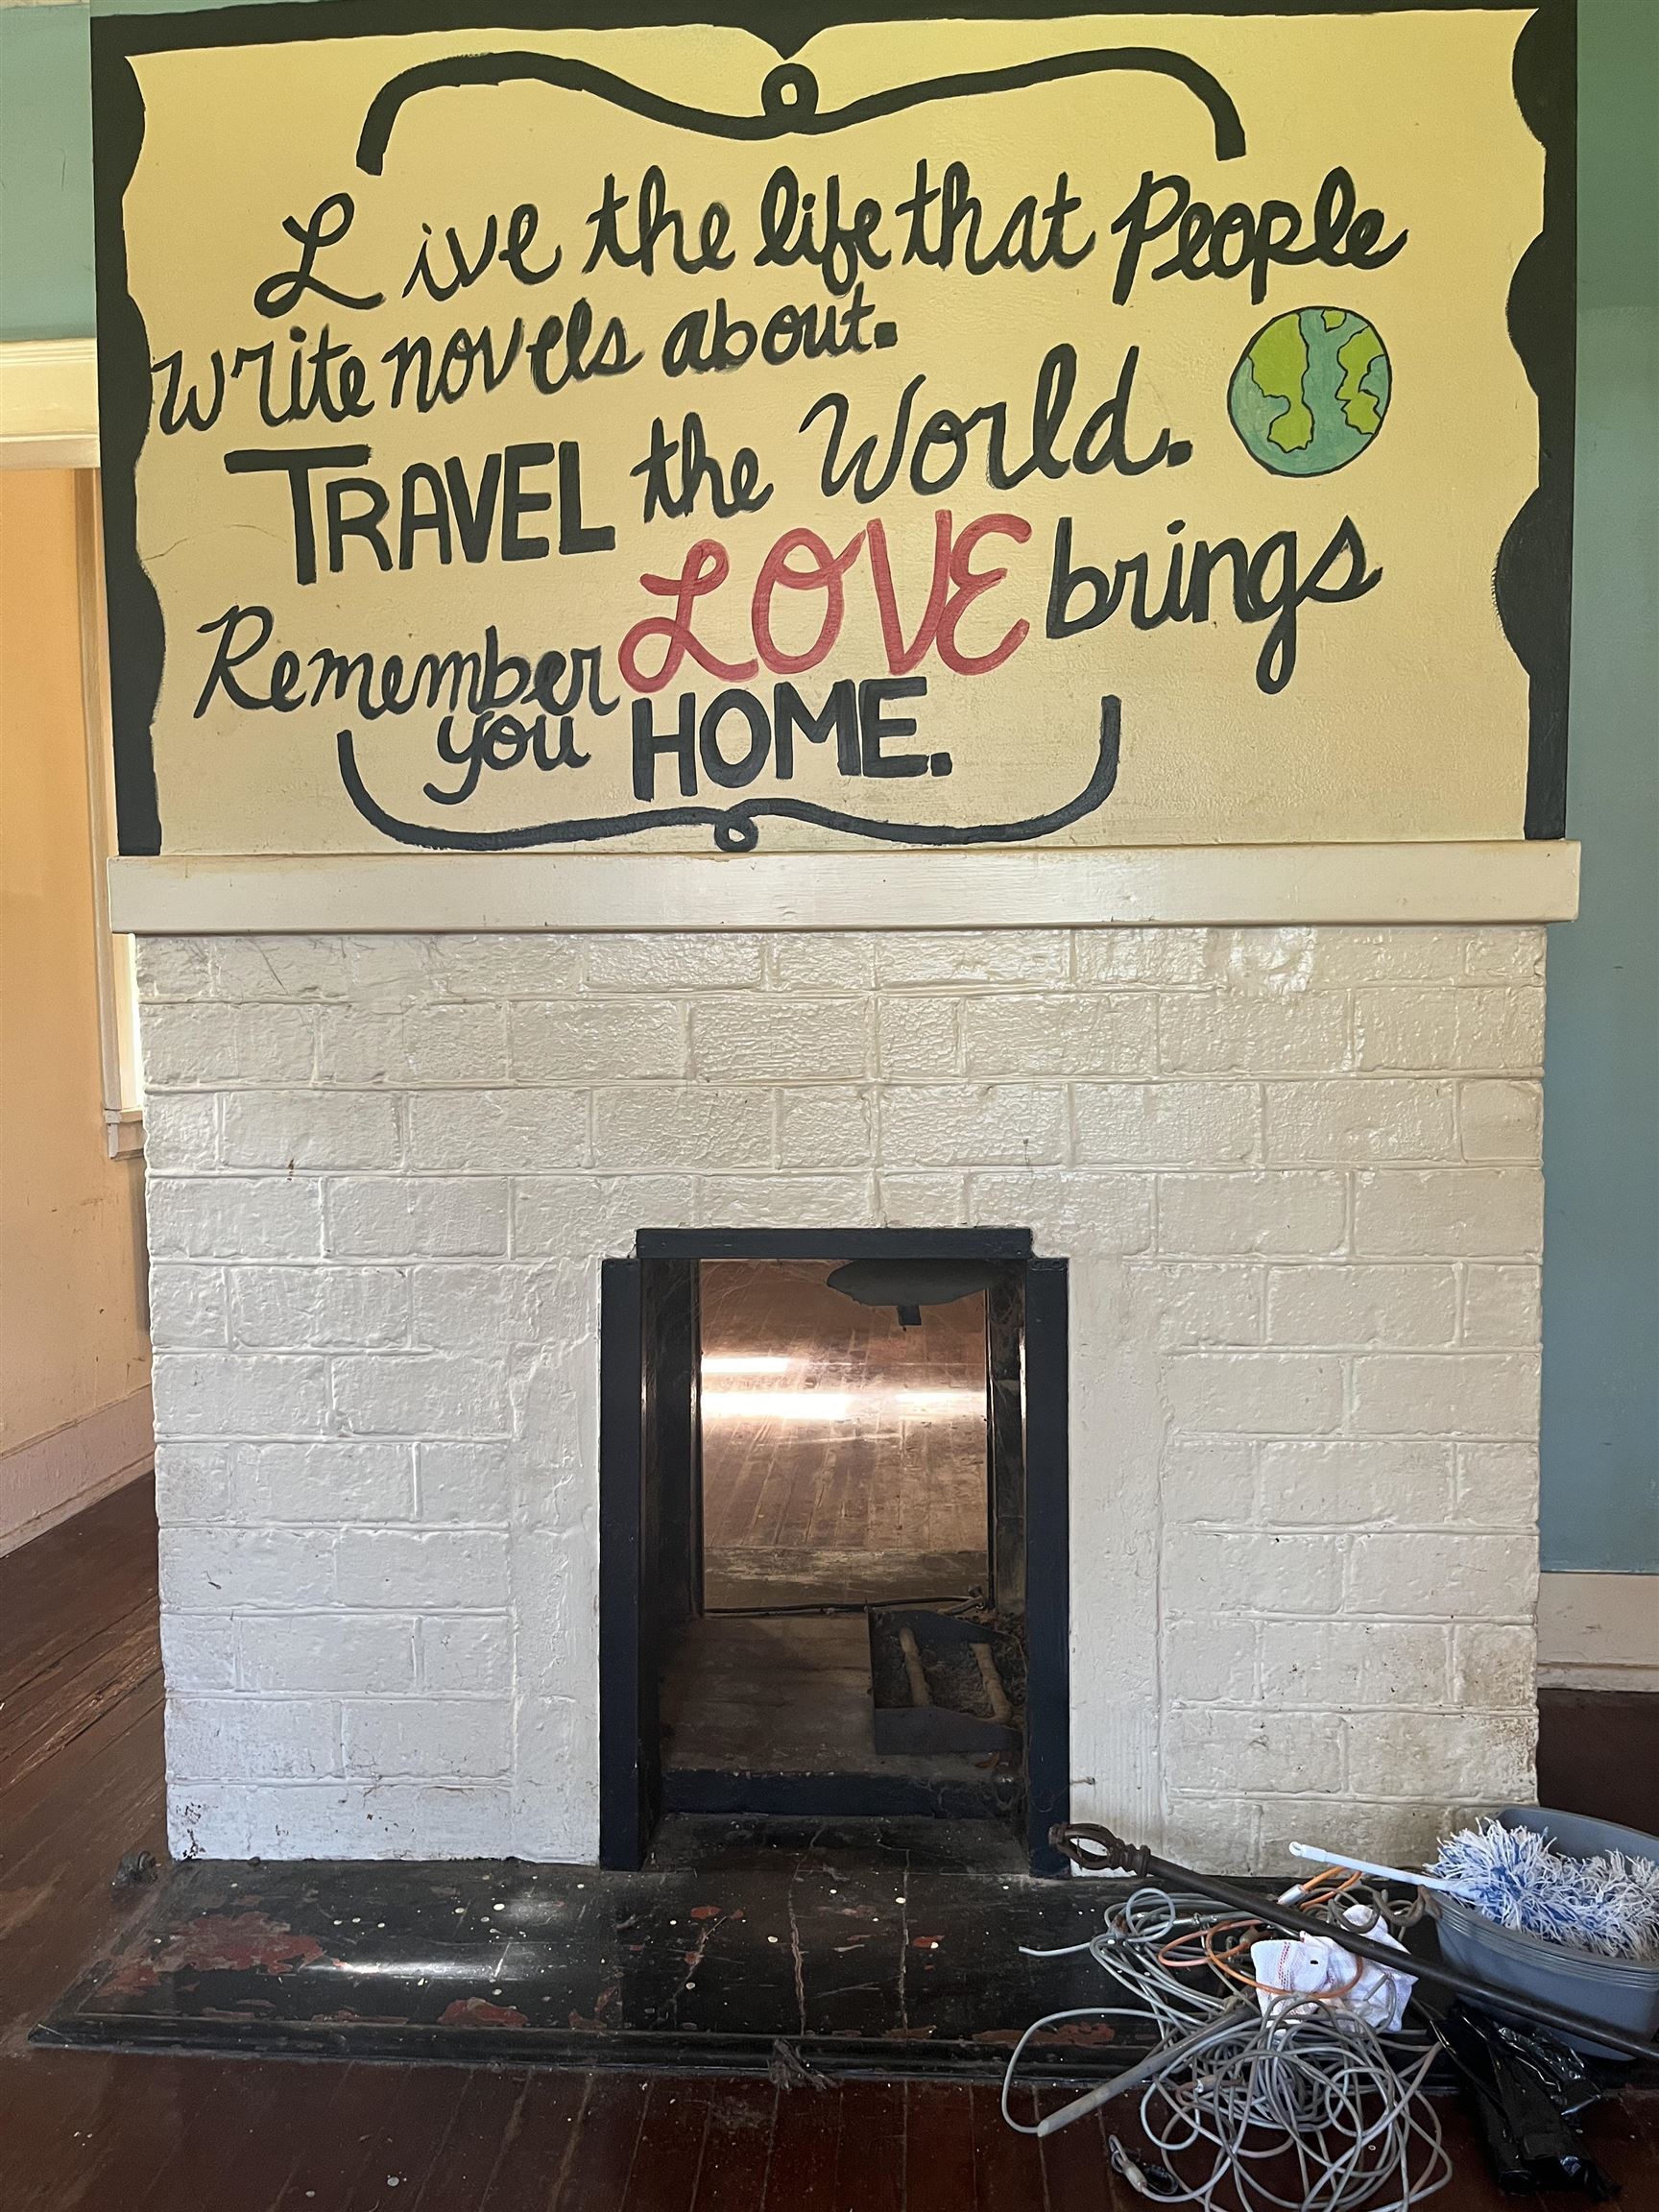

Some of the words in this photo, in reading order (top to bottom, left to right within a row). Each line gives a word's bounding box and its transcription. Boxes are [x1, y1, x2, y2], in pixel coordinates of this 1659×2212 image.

[253, 192, 563, 318] Live
[578, 166, 736, 276] the
[754, 166, 891, 296] life
[896, 159, 1095, 276] that
[382, 299, 645, 413] novels
[662, 283, 897, 377] about.
[224, 442, 615, 585] TRAVEL
[631, 414, 774, 523] the
[800, 343, 1192, 504] World.
[193, 605, 621, 718] Remember
[617, 509, 1032, 694] LOVE
[1046, 516, 1382, 694] brings
[423, 710, 590, 805] you
[631, 676, 953, 803] HOME.
